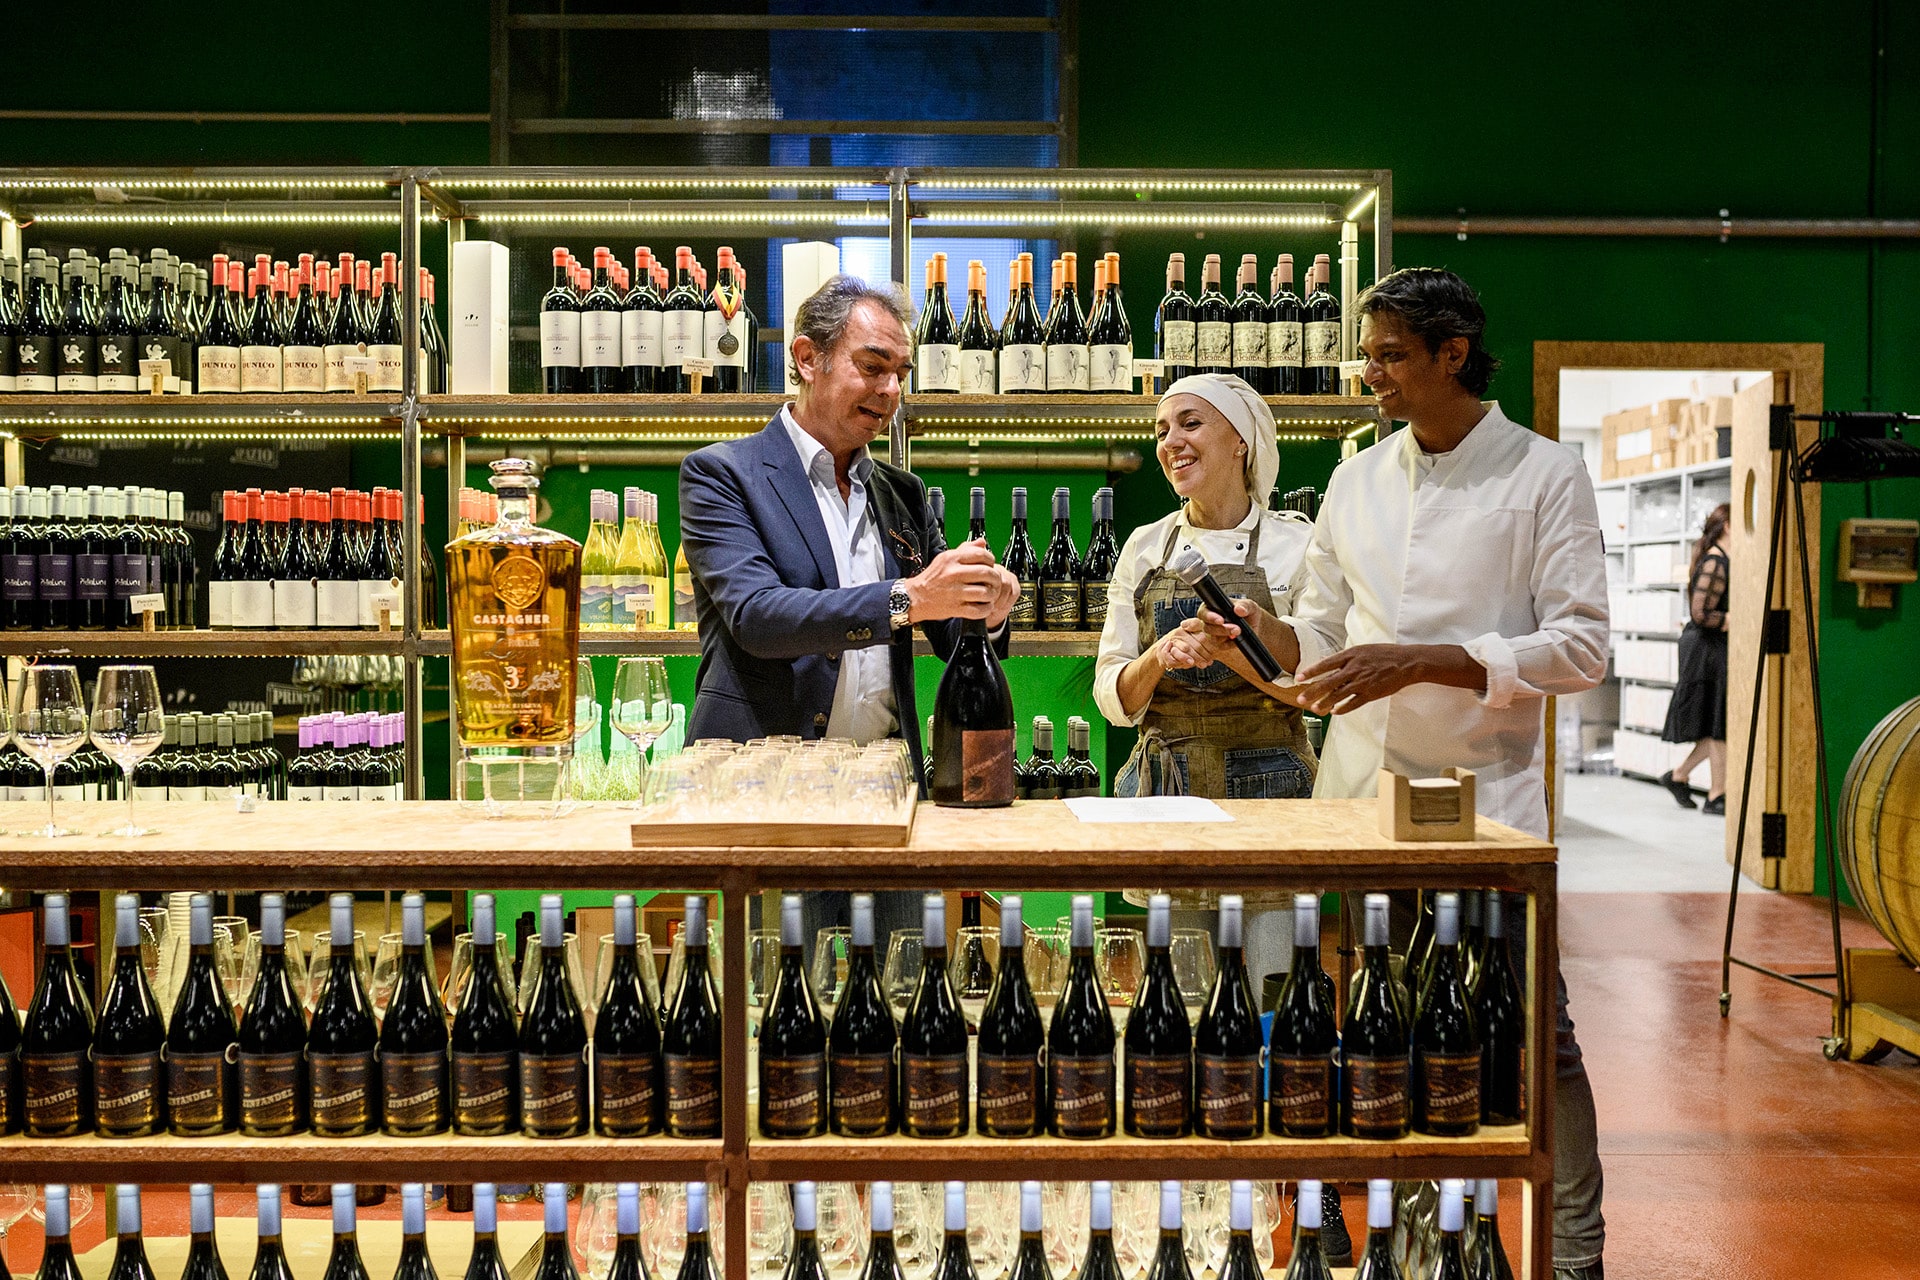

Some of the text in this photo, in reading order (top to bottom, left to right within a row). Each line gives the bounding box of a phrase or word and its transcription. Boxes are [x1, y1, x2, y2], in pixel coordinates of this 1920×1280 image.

[201, 361, 236, 370] DUNICO
[242, 361, 275, 369] DUNICO
[285, 361, 318, 369] DUNICO
[377, 360, 401, 368] NICO
[1010, 601, 1034, 613] FANDEL
[1046, 601, 1077, 614] ZINFANDEL
[473, 614, 551, 625] CASTAGNER
[26, 1088, 78, 1108] ZINFANDEL
[98, 1088, 150, 1109] ZINFANDEL
[168, 1089, 213, 1106] ZINFANDEL
[242, 1088, 294, 1108] ZINFANDEL
[313, 1088, 365, 1108] ZINFANDEL
[388, 1086, 440, 1108] ZINFANDEL
[458, 1087, 510, 1108] ZINFANDEL
[524, 1090, 575, 1109] ZINFANDEL
[603, 1088, 653, 1109] ZINFANDEL
[669, 1090, 718, 1110] ZINFANDEL
[768, 1090, 818, 1110] ZINFANDEL
[833, 1090, 882, 1108] ZINFANDEL
[909, 1090, 959, 1110] ZINFANDEL
[980, 1091, 1028, 1108] ZINFANDEL
[1054, 1091, 1105, 1110] ZINFANDEL
[1132, 1090, 1183, 1109] ZINFANDEL
